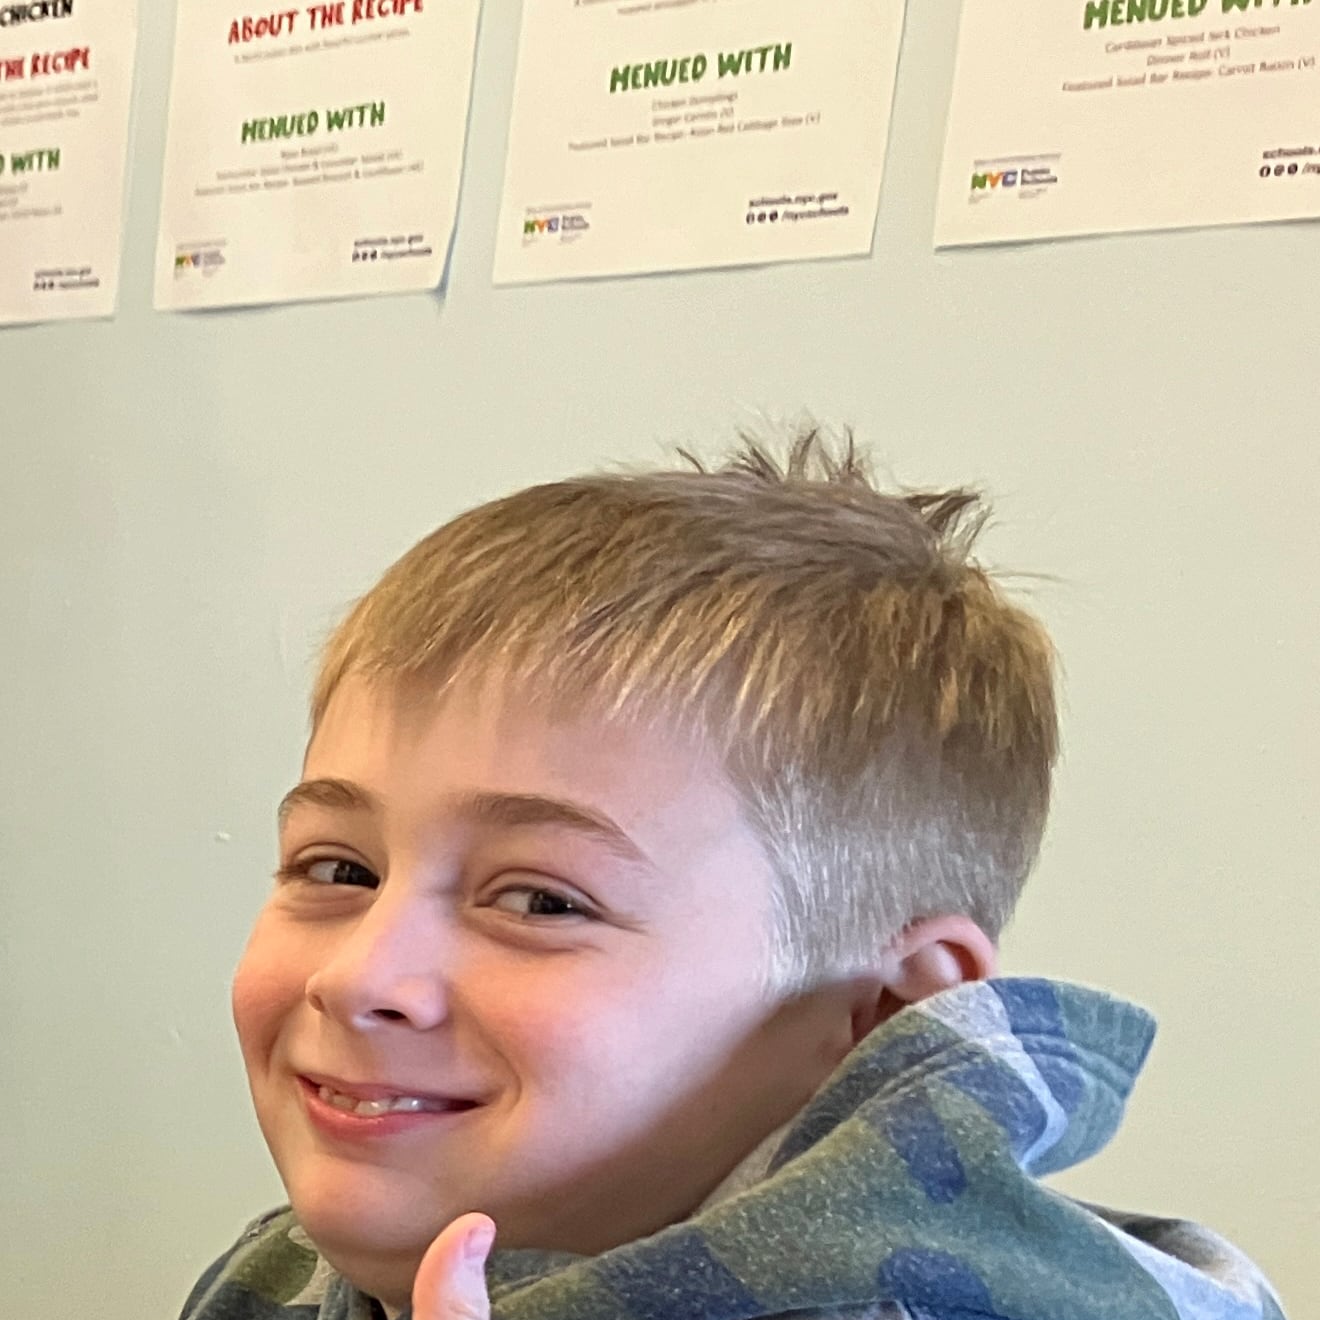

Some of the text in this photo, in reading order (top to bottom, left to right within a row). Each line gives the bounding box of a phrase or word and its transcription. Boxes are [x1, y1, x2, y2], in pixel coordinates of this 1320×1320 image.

[227, 10, 298, 45] ABOUT
[306, 2, 345, 30] THE
[31, 46, 90, 77] RECIPE
[610, 42, 792, 93] MENUED WITH
[241, 101, 386, 144] MENUED WITH
[11, 148, 60, 175] WITH
[971, 170, 1018, 190] NYC
